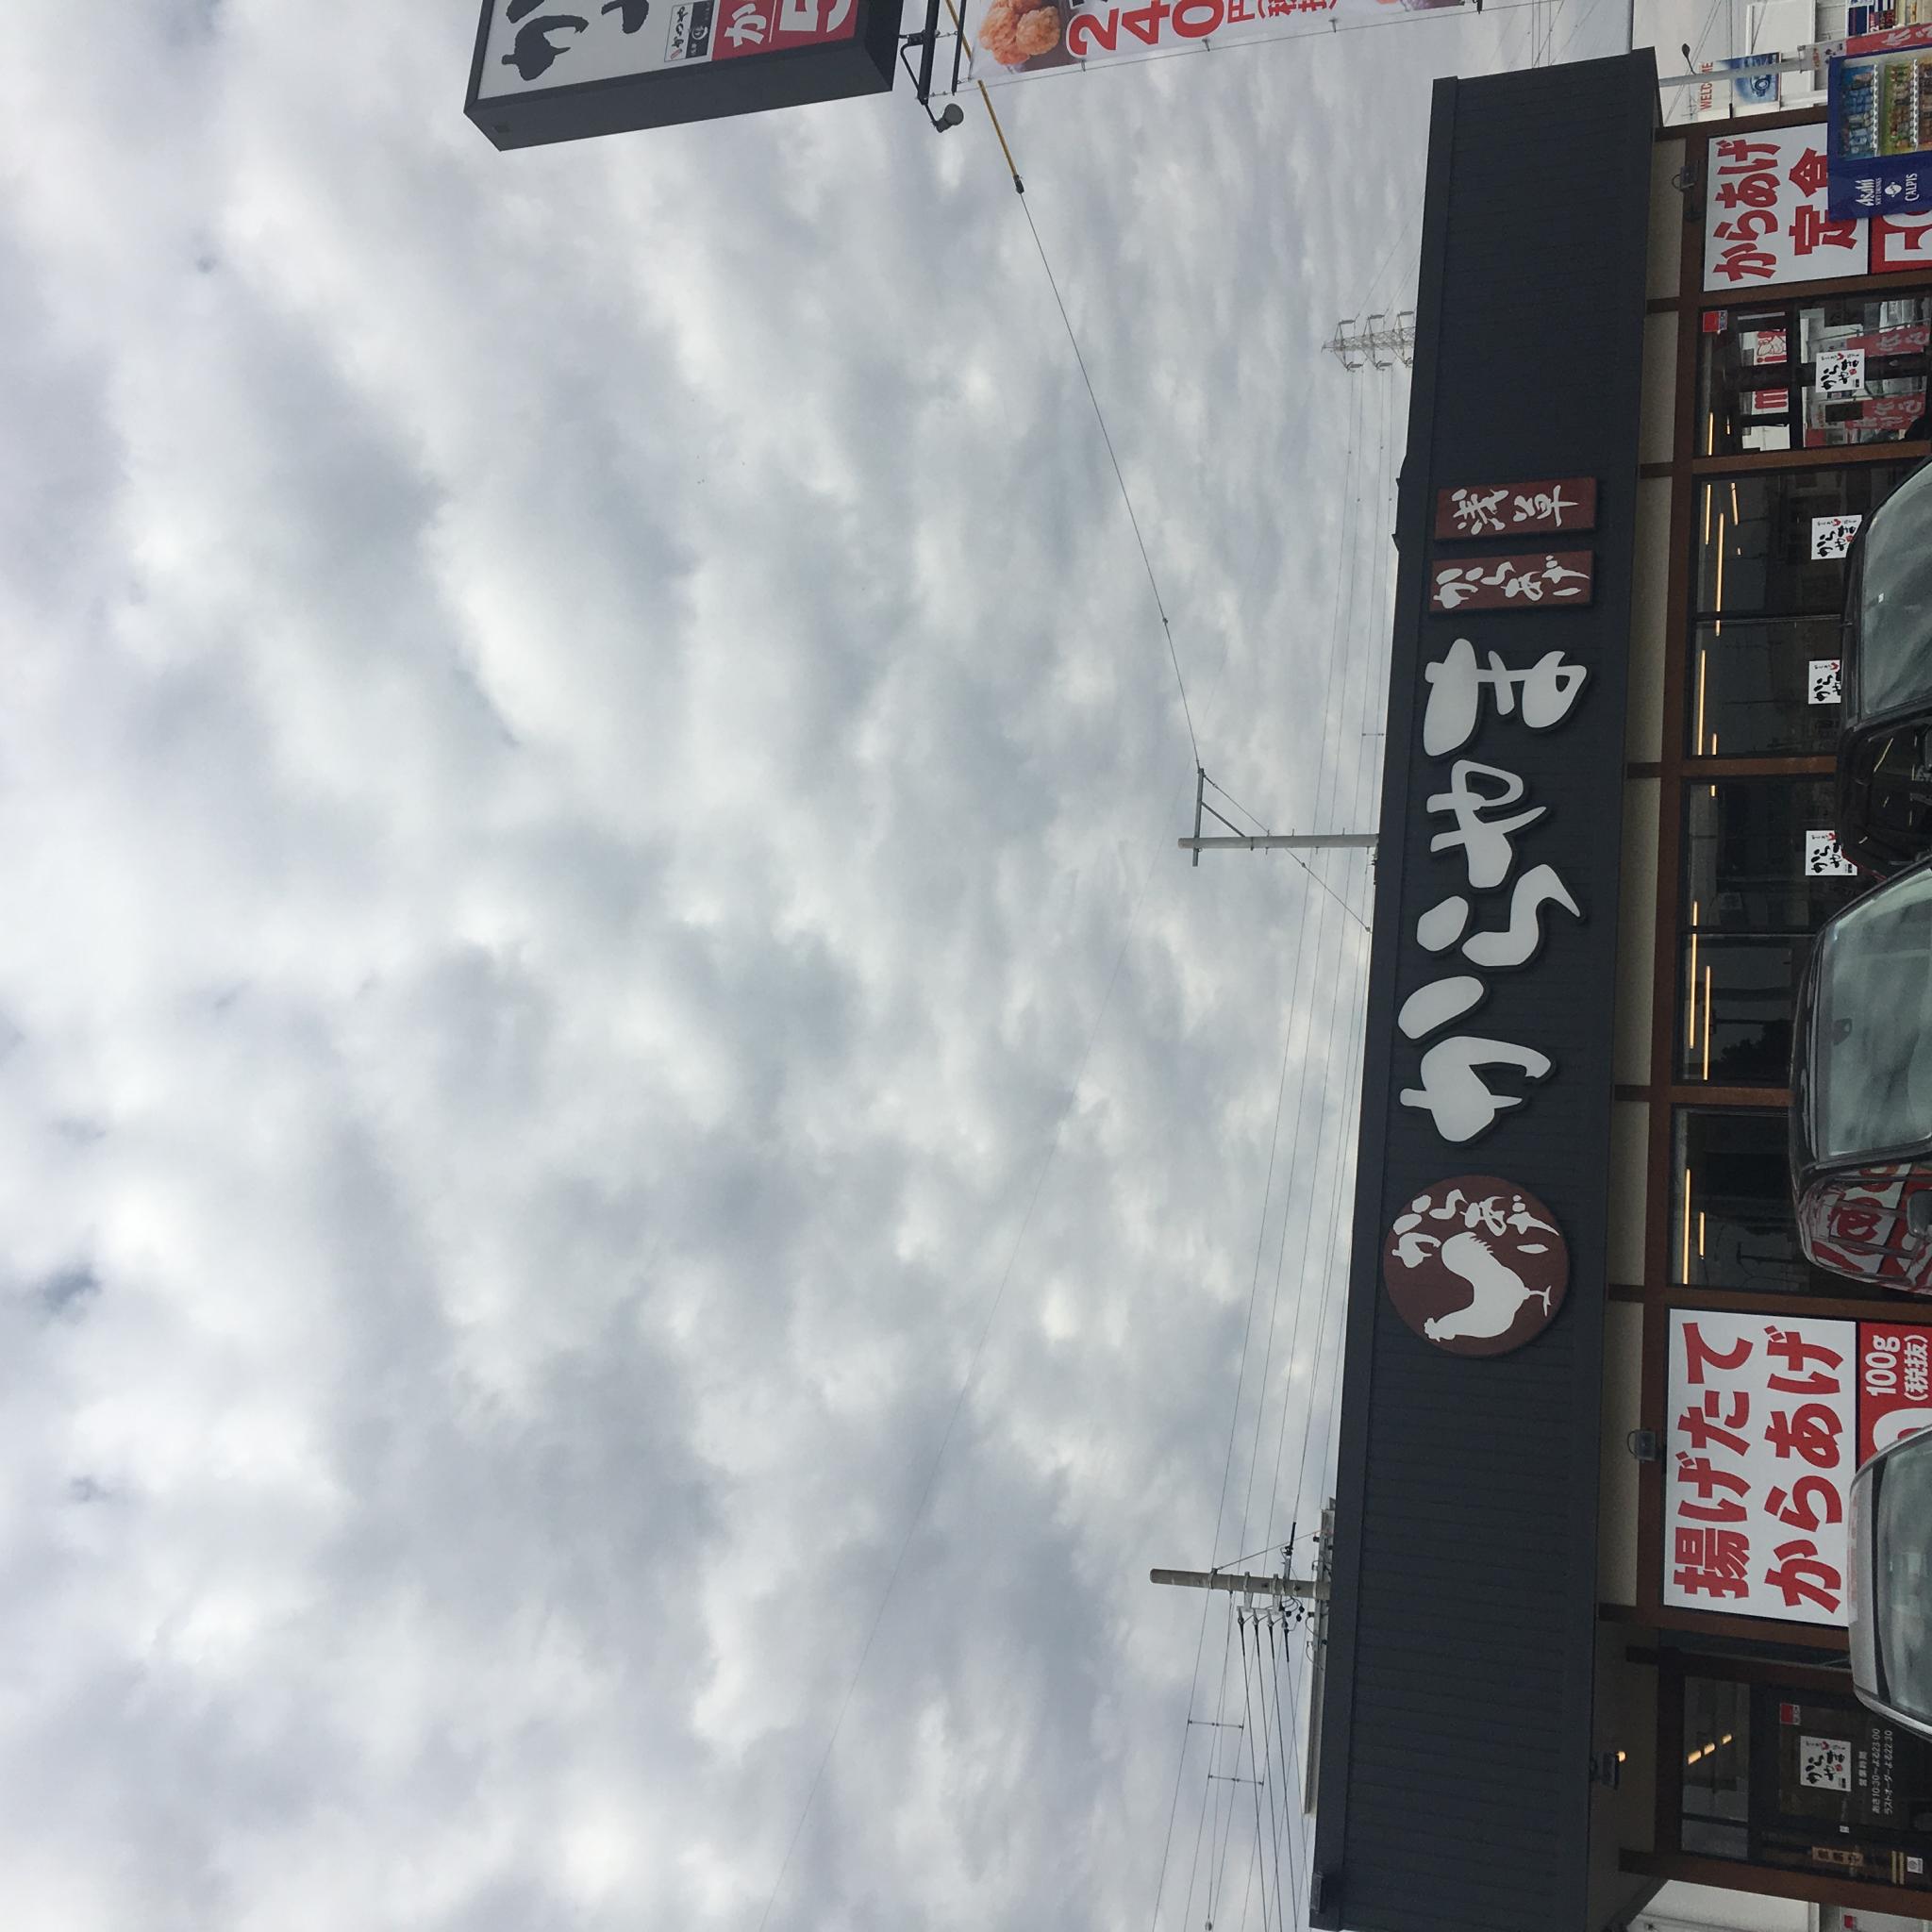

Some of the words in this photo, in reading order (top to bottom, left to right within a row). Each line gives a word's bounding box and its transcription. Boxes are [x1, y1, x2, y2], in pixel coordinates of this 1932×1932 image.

[1700, 61, 1713, 110] WELCME
[1713, 139, 1781, 281] からあげ
[1855, 178, 1875, 207] Asahi
[1904, 173, 1920, 202] CALPIS
[1451, 484, 1579, 535] 浅草
[1433, 555, 1591, 609] からあげ
[1397, 638, 1589, 1141] からやま
[1391, 1189, 1559, 1269] からあげ
[1866, 1335, 1900, 1397] 100g
[1674, 1322, 1754, 1599] 揚げたて
[1764, 1324, 1843, 1614] からあげ
